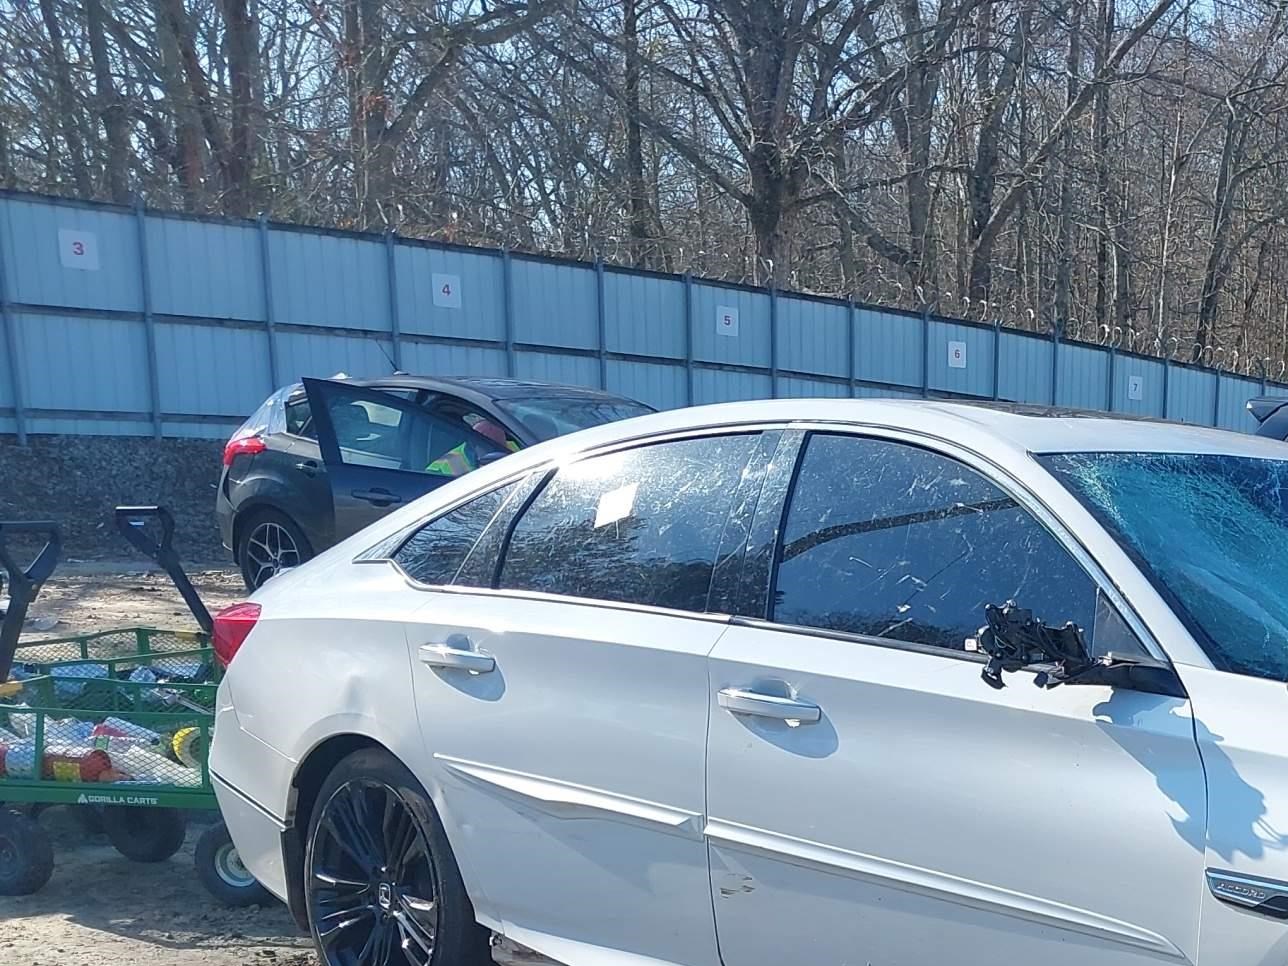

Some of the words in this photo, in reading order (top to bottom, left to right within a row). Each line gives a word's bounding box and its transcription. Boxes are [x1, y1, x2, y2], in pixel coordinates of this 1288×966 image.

[72, 241, 85, 256] 3
[442, 283, 451, 297] 4
[724, 315, 731, 326] 5
[954, 349, 961, 359] 6
[1133, 383, 1138, 392] 7
[88, 795, 125, 804] GORILLA
[127, 797, 158, 805] CARTS
[1217, 883, 1265, 899] ACCORD
